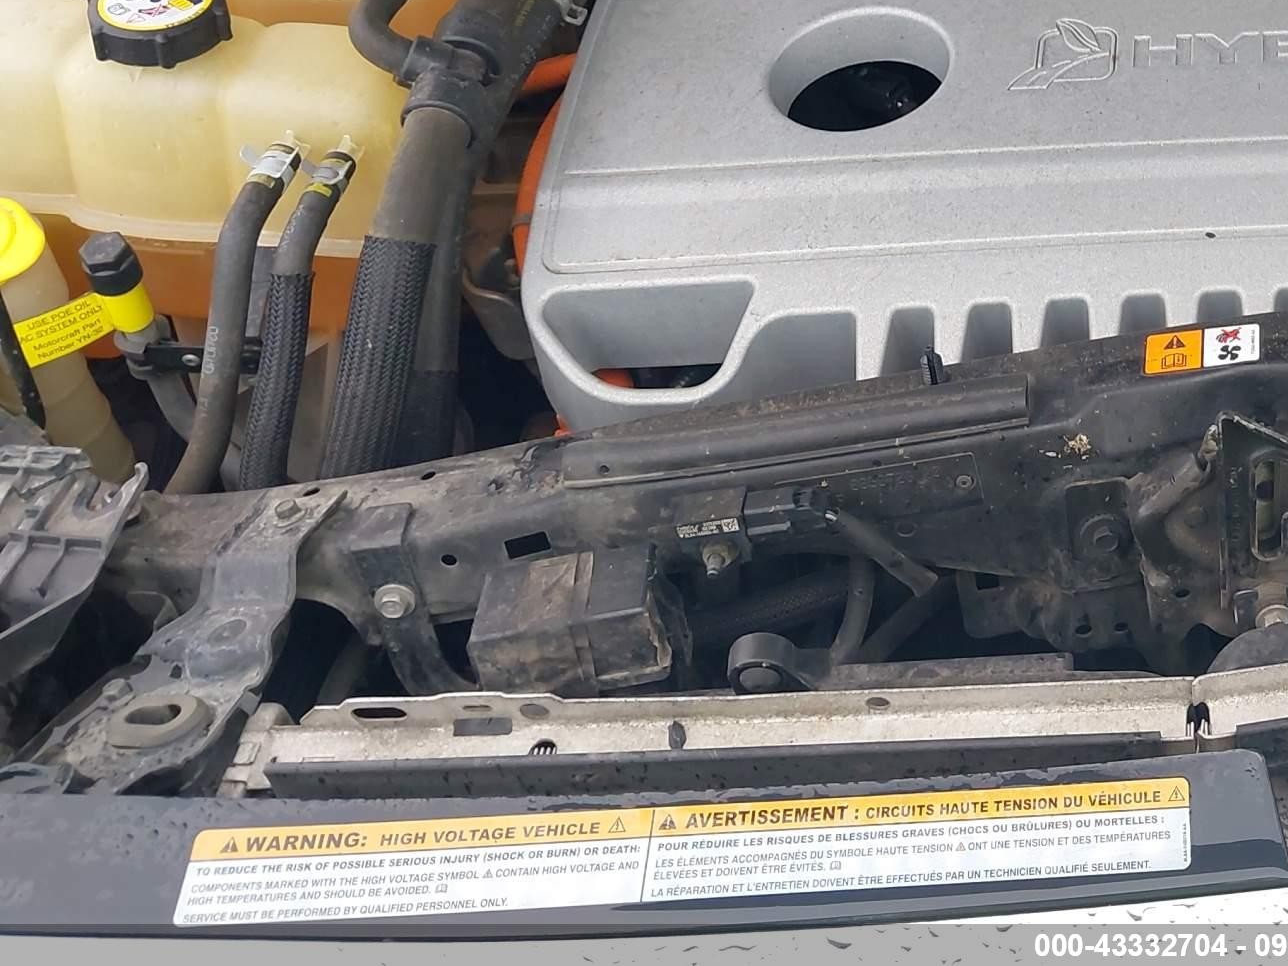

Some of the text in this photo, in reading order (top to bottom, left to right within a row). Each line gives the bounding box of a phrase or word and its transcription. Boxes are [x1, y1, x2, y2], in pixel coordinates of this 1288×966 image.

[27, 300, 91, 331] USE POE OIL
[35, 316, 78, 338] SYSTEM
[79, 305, 102, 320] ONLY
[33, 318, 101, 351] Motorcraft Part
[37, 341, 75, 359] Number
[685, 804, 849, 829] AVERTISSEMENT
[865, 803, 934, 819] CIRCUITS
[939, 800, 989, 815] HAUTE
[992, 796, 1058, 812] TENSION
[1063, 794, 1083, 808] DU
[1087, 790, 1161, 807] VÉHICULE
[242, 821, 601, 853] WARNING: HIGH VOLTAGE VEHICLE
[657, 841, 689, 851] POUR
[742, 836, 763, 847] LES
[766, 834, 814, 845] RISQUES
[817, 833, 832, 843] DE
[834, 829, 898, 842] BLESSURES
[901, 827, 944, 838] GRAVES
[947, 824, 989, 836] (CHOCS
[992, 823, 1007, 833] OU
[1075, 818, 1091, 828] OU
[1094, 814, 1158, 827] MORTELLES
[195, 866, 211, 876] TO
[212, 864, 258, 876] REDUCE
[260, 863, 283, 873] THE
[284, 862, 312, 872] RISK
[313, 861, 330, 871] OF
[331, 858, 386, 870] POSSIBLE
[387, 855, 437, 867] SERIOUS
[439, 853, 480, 864] INJURY
[482, 850, 525, 862] (SHOCK
[527, 849, 544, 859] OR
[545, 847, 581, 858] BURN)
[582, 846, 599, 856] OR
[189, 860, 640, 894] COMPONENTS MARKED WITH THE HIGH VOLTAGE SYMBOL CONTAIN HIGH VOLTAGE AND
[650, 887, 664, 897] LA
[731, 882, 744, 893] ET
[746, 879, 810, 892] L'ENTRETIEN
[811, 876, 855, 888] DOIVENT
[944, 870, 965, 880] PAR
[967, 869, 981, 879] UN
[982, 866, 1042, 878] TECHNICIEN
[182, 912, 228, 925] SERVICE
[228, 910, 259, 921] MUST
[259, 909, 275, 920] BE
[276, 905, 342, 919] PERFORMED
[342, 905, 358, 915] BY
[358, 902, 414, 915] QUALIFIED
[414, 898, 479, 911] PERSONNEL
[186, 895, 214, 906] HIGH
[214, 891, 298, 905] TEMPERATURES
[298, 890, 322, 900] AND
[322, 887, 367, 900] SHOULD
[366, 887, 383, 897] BE
